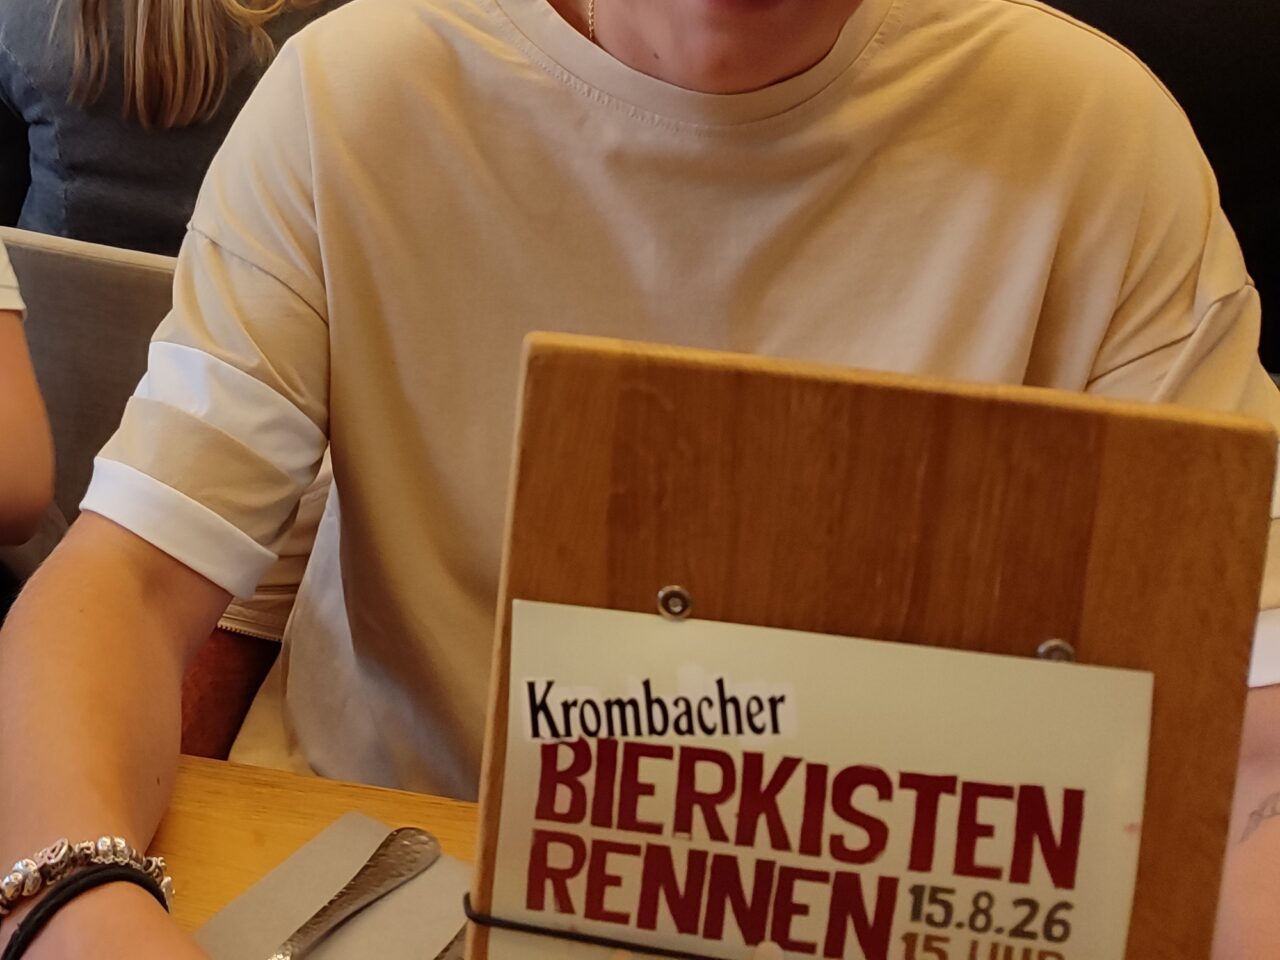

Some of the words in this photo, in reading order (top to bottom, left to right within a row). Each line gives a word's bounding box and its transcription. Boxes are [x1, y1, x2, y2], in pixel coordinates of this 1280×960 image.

[526, 677, 786, 738] Krombacher
[534, 737, 1085, 890] BIERKISTEN
[526, 829, 899, 960] RENNEN
[909, 884, 1075, 943] 15.8.26
